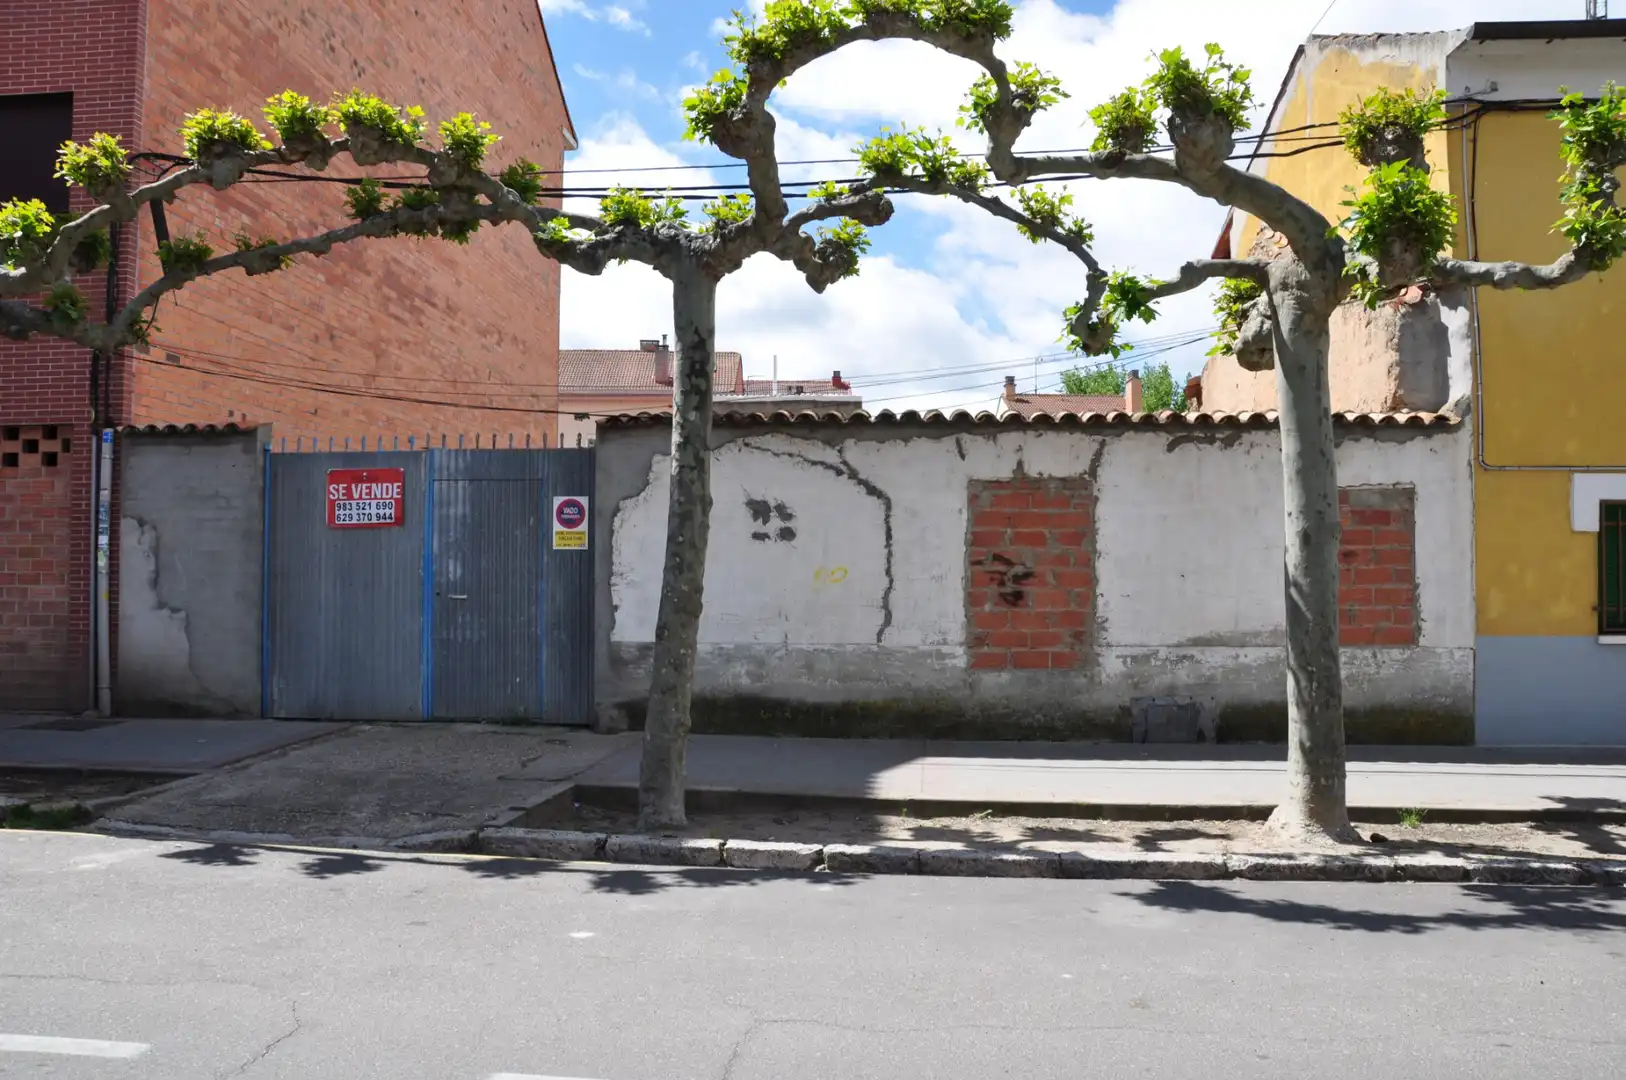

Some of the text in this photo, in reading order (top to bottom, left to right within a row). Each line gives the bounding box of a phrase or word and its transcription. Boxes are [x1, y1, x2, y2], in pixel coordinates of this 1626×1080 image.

[329, 482, 402, 499] SE VENDE
[336, 501, 393, 511] 983 521 690
[336, 512, 393, 522] 629 370 944
